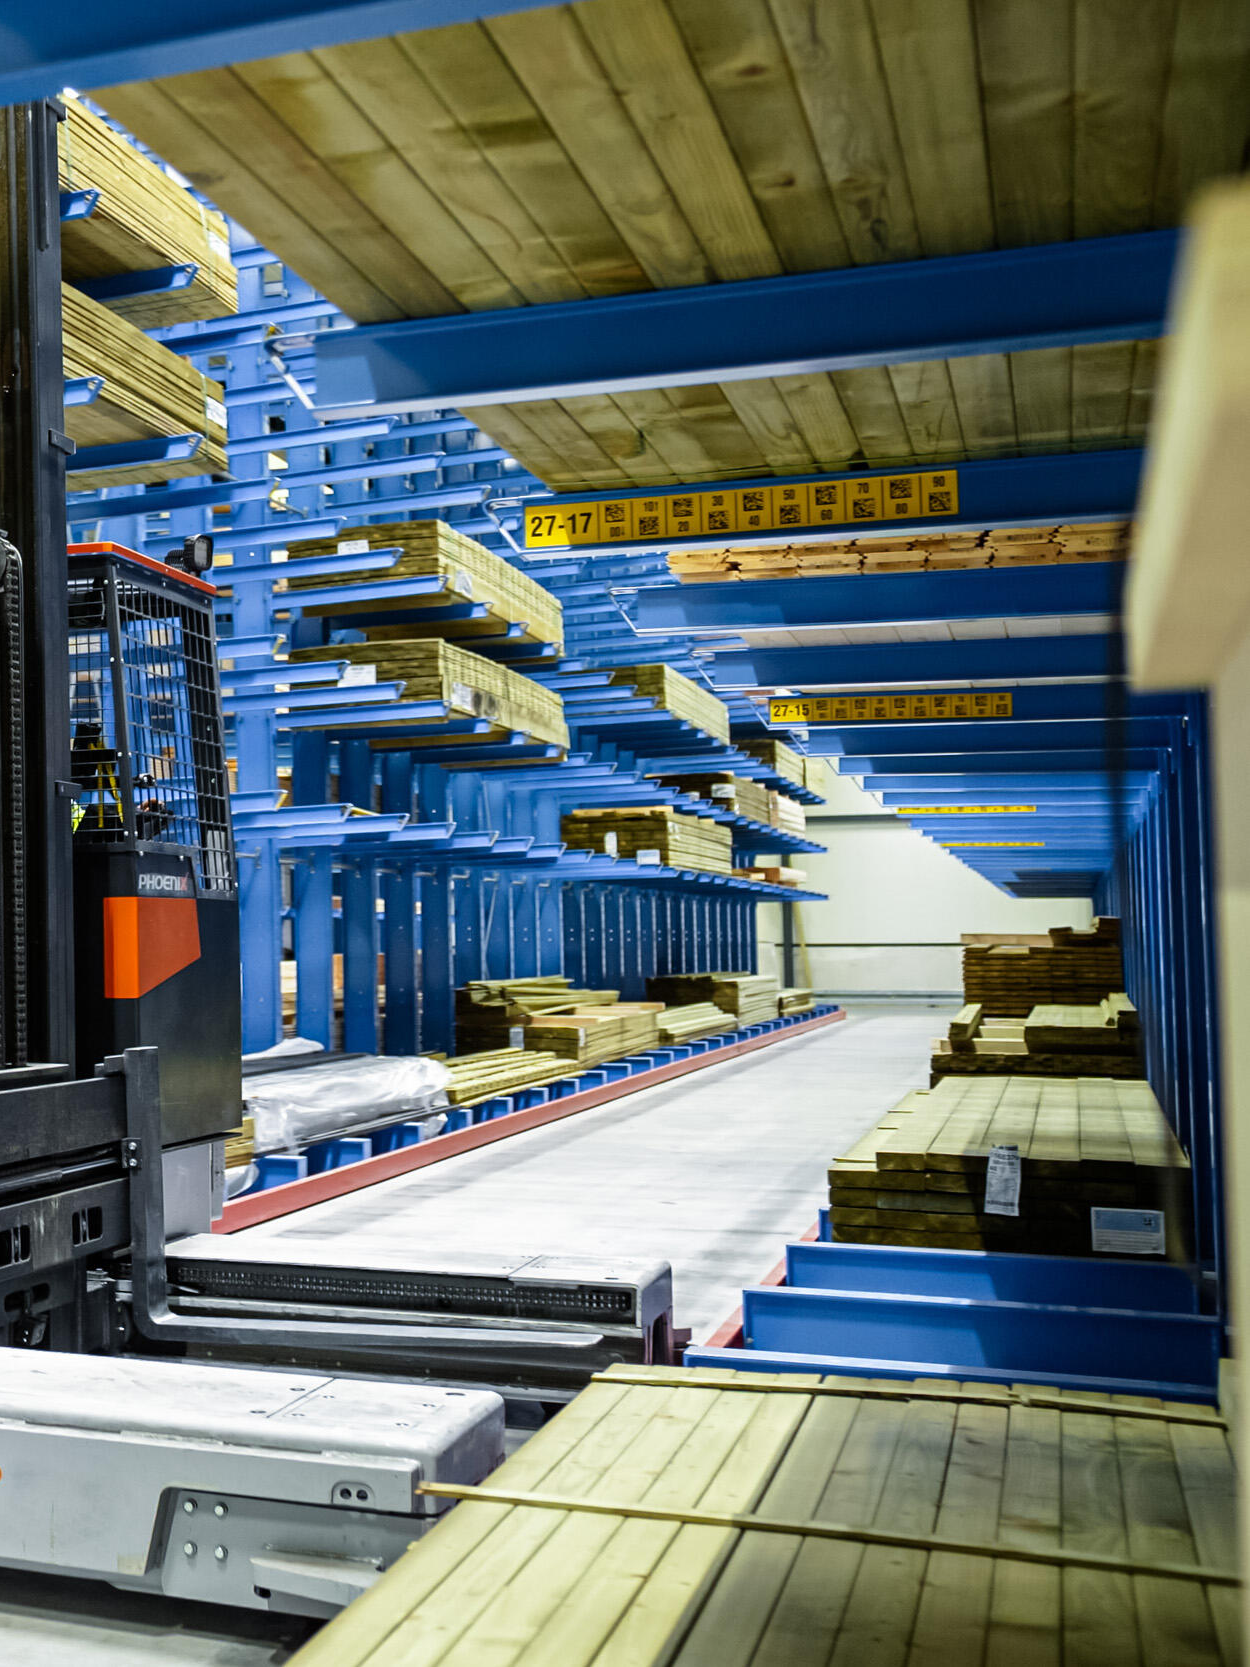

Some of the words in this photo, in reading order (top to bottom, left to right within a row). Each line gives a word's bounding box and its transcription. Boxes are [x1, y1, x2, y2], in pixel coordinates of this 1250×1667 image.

[782, 489, 795, 500] 50
[857, 482, 869, 494] 70
[530, 512, 592, 537] 27-17
[773, 704, 810, 717] 27-15
[138, 872, 189, 891] PHOENIX
